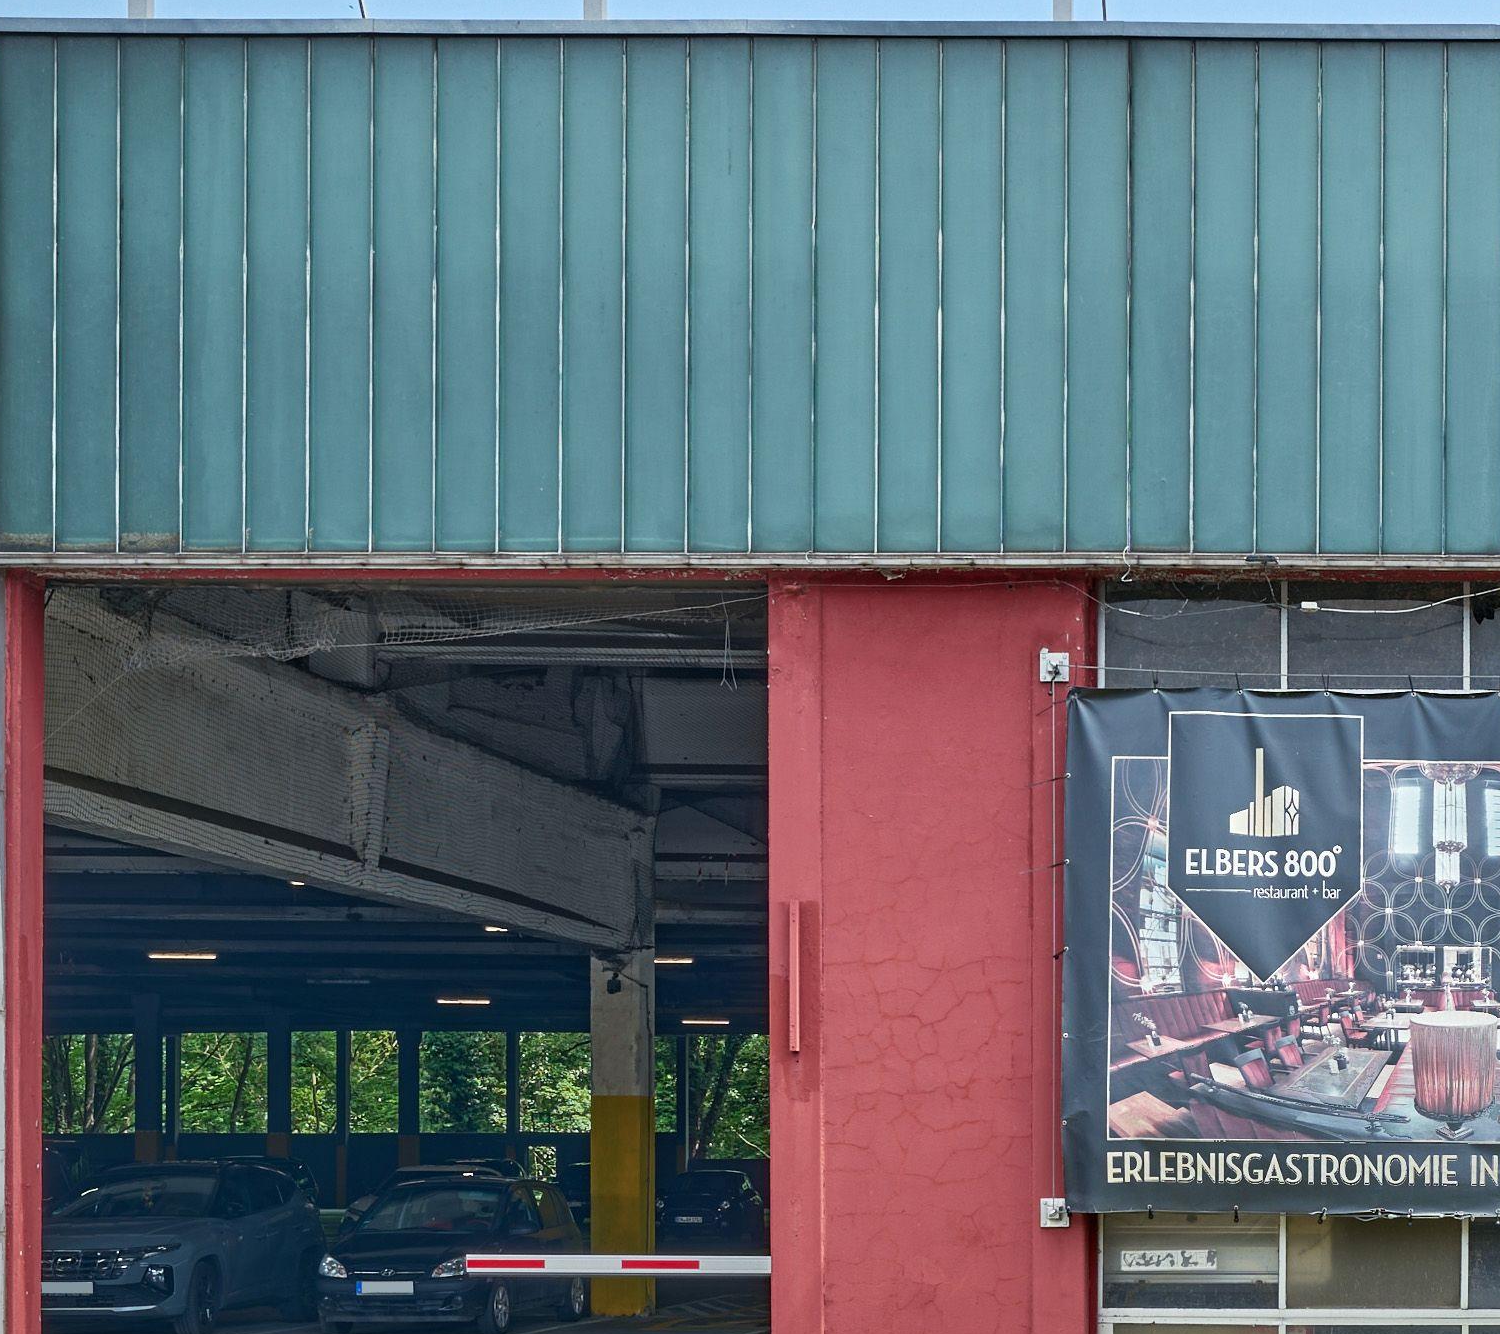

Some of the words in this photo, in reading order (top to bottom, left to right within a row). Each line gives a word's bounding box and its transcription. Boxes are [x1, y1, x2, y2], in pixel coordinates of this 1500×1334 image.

[1185, 848, 1279, 877] ELBERS
[1253, 884, 1309, 900] restaurant
[1322, 880, 1342, 900] bar
[1106, 1151, 1460, 1187] ERLEBNISGASTRONOMIE
[1470, 1154, 1499, 1187] IN
